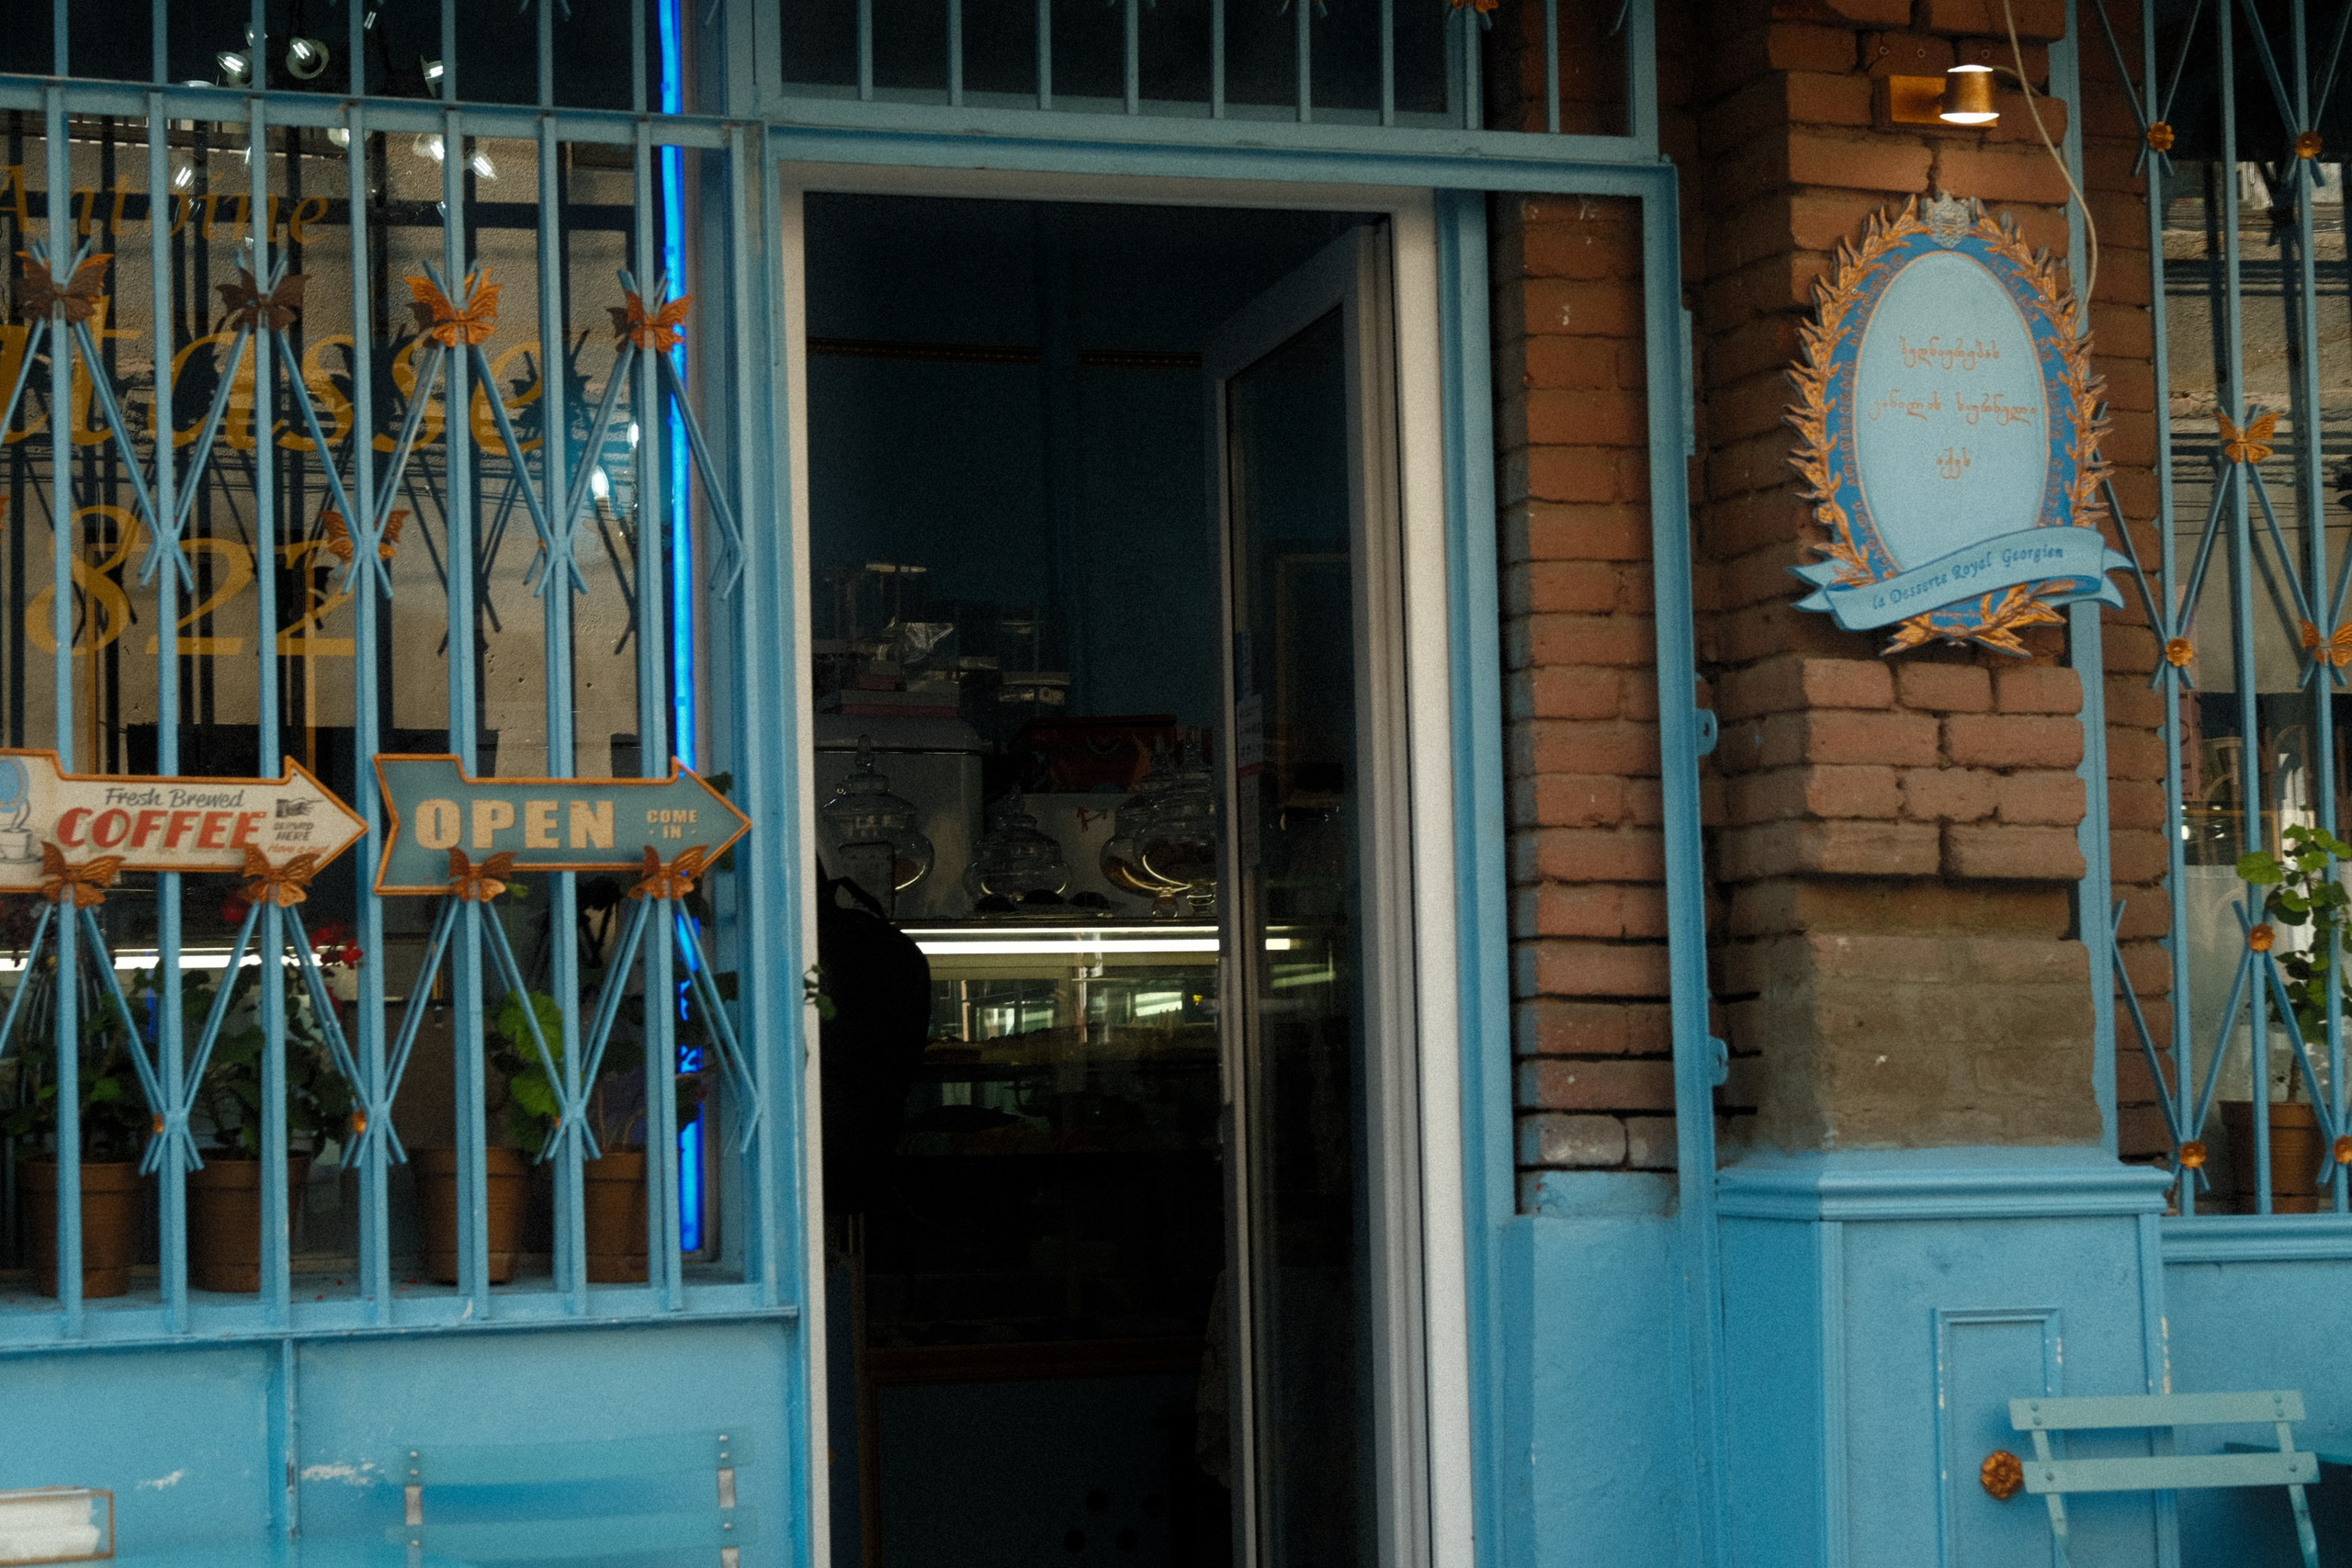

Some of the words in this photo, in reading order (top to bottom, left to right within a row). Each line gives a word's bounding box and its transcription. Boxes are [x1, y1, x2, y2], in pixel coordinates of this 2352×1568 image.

[1951, 551, 1993, 580] Royal
[2001, 543, 2064, 569] Georgien
[105, 787, 164, 807] Fresh
[168, 788, 245, 808] Brewed
[414, 798, 615, 850] OPEN
[647, 809, 698, 823] COME
[56, 807, 268, 850] COFFEE
[276, 830, 312, 841] HERE
[662, 824, 683, 840] IN
